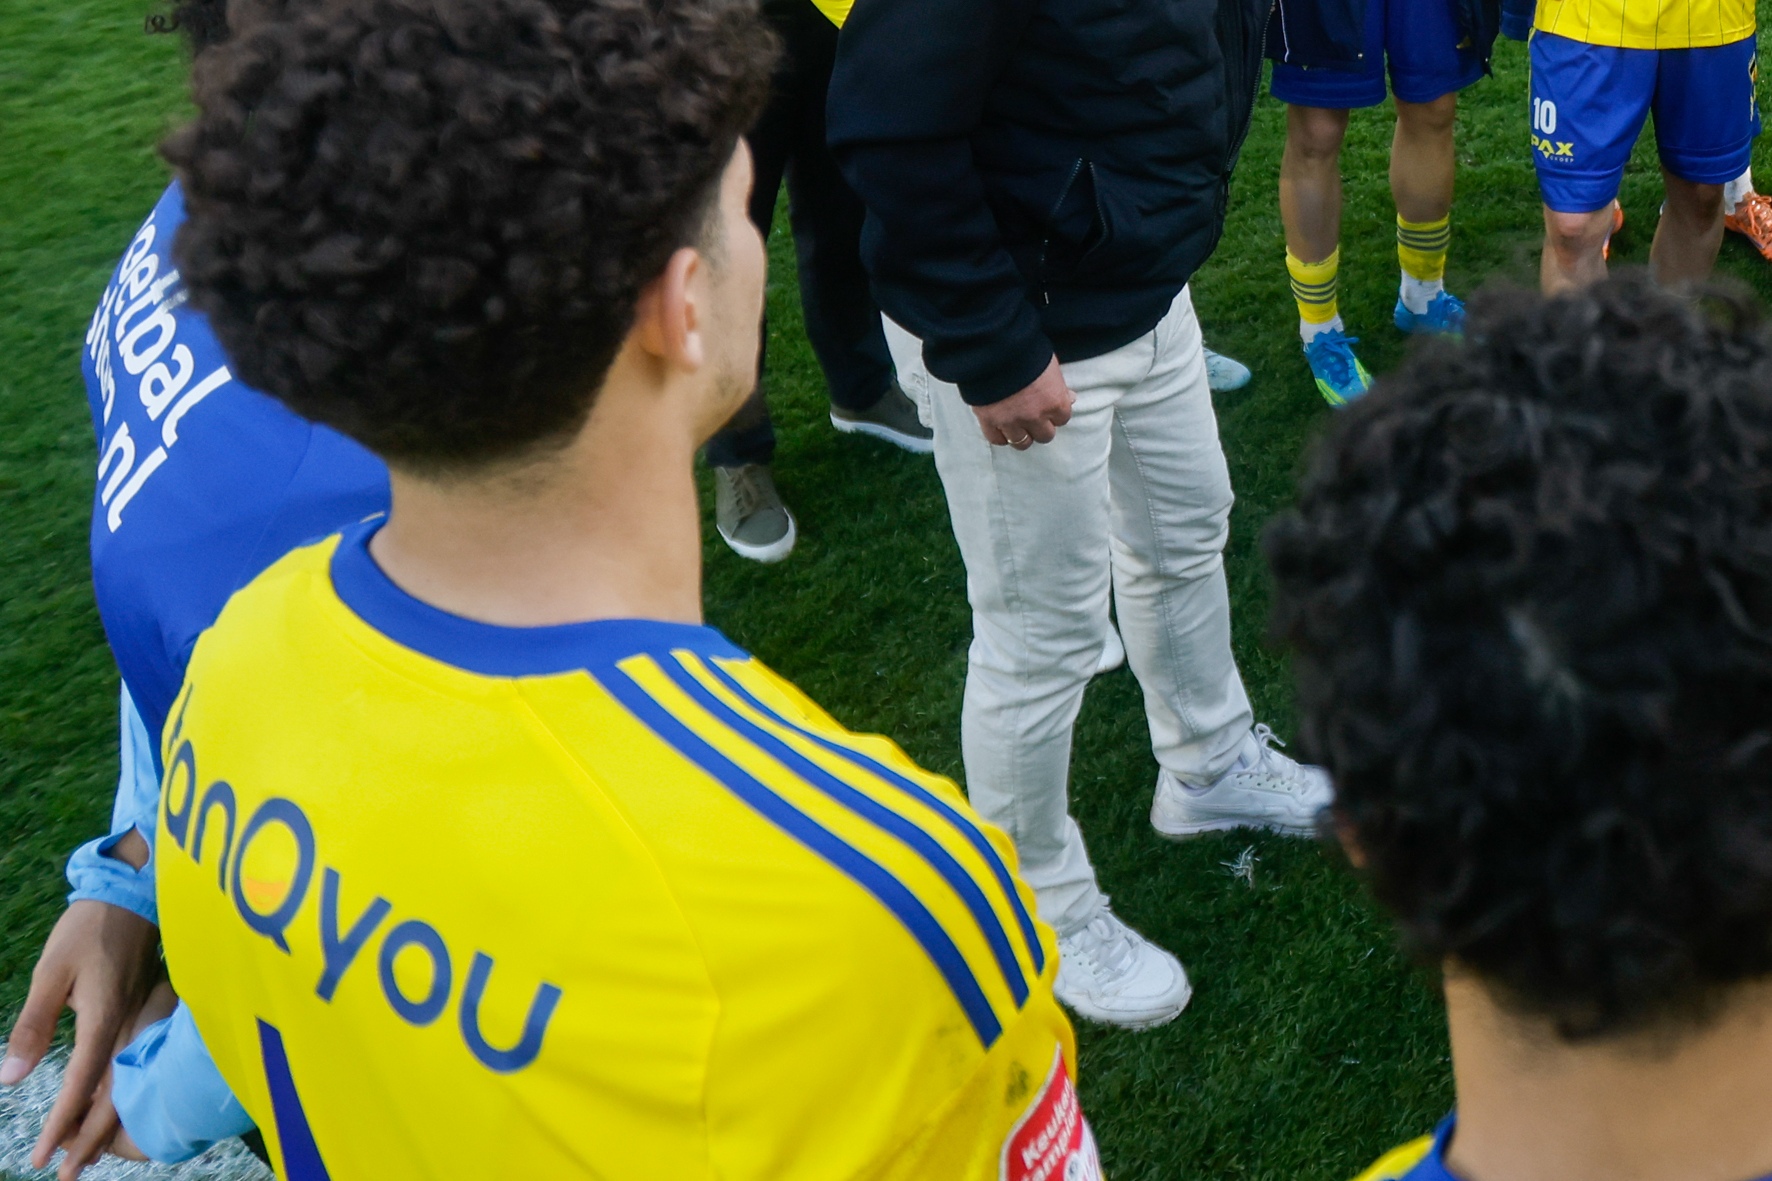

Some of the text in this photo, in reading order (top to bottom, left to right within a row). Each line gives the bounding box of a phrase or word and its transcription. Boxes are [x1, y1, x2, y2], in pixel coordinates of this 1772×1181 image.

[1533, 96, 1557, 135] 10
[1531, 133, 1574, 158] PAX
[115, 209, 233, 449] oetbal
